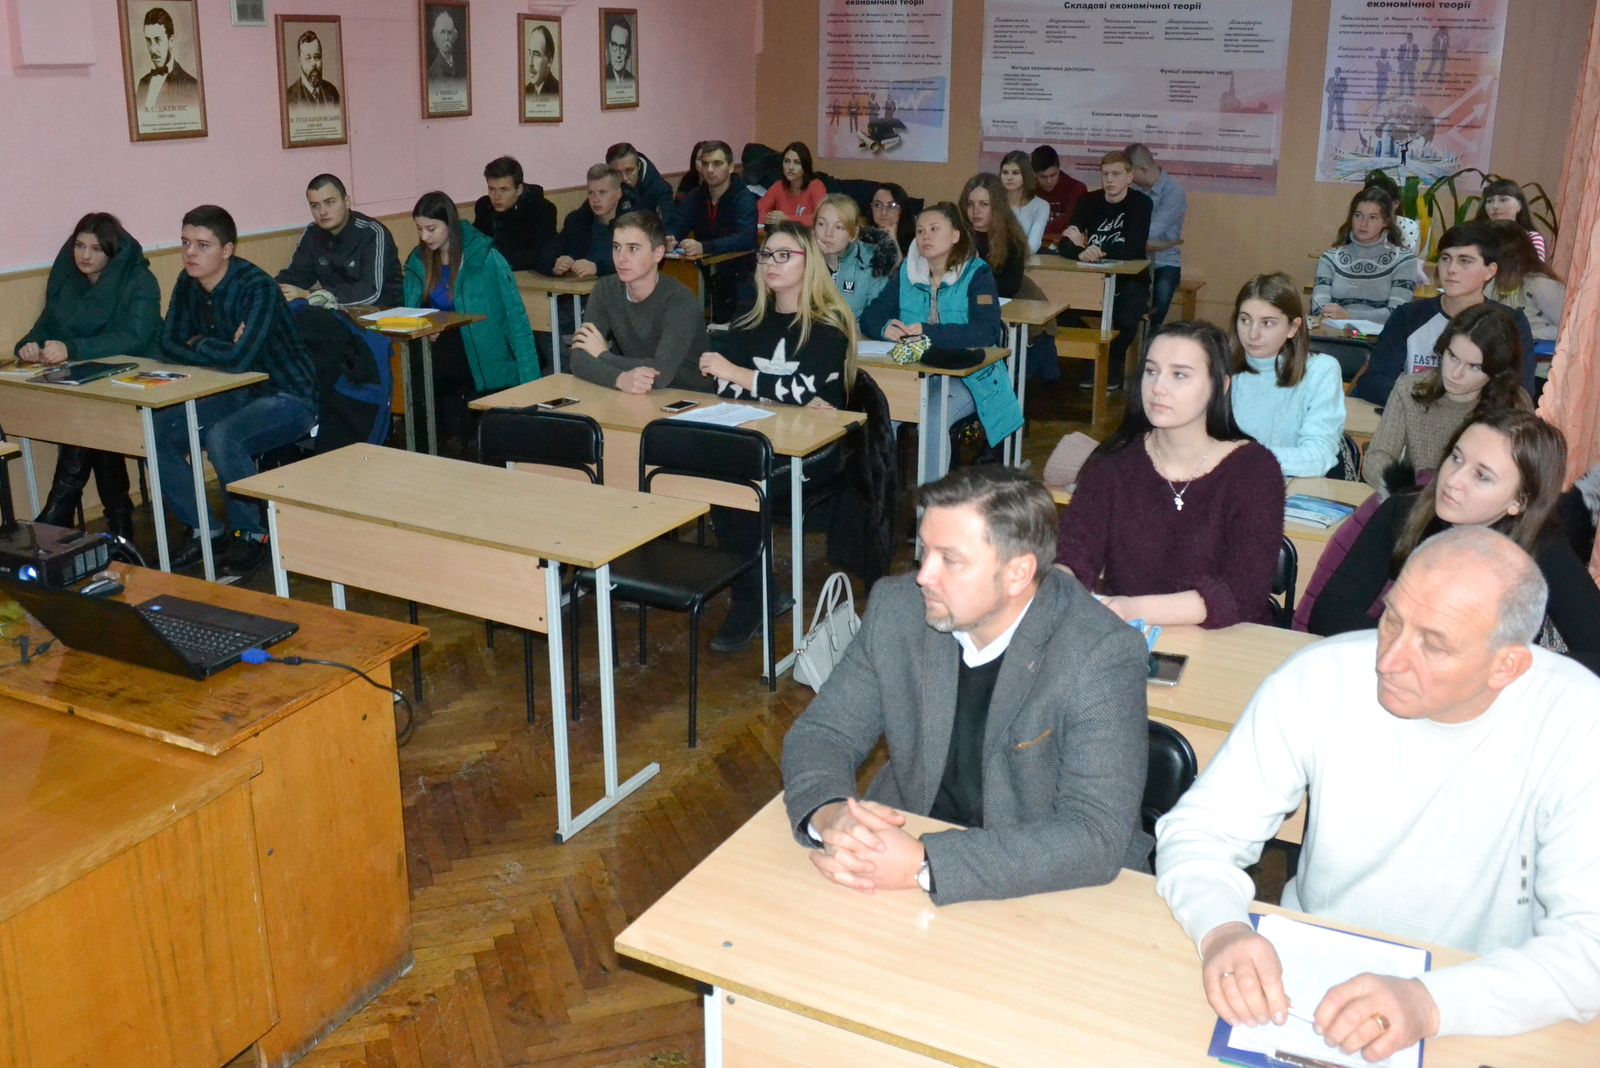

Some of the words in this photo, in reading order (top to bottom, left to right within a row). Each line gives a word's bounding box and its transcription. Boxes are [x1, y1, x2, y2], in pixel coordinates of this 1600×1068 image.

[1064, 1, 1107, 10] Складові
[1110, 2, 1170, 10] економічної
[1173, 2, 1202, 11] теорії
[1366, 0, 1435, 9] економічної
[1438, 0, 1471, 10] теорії
